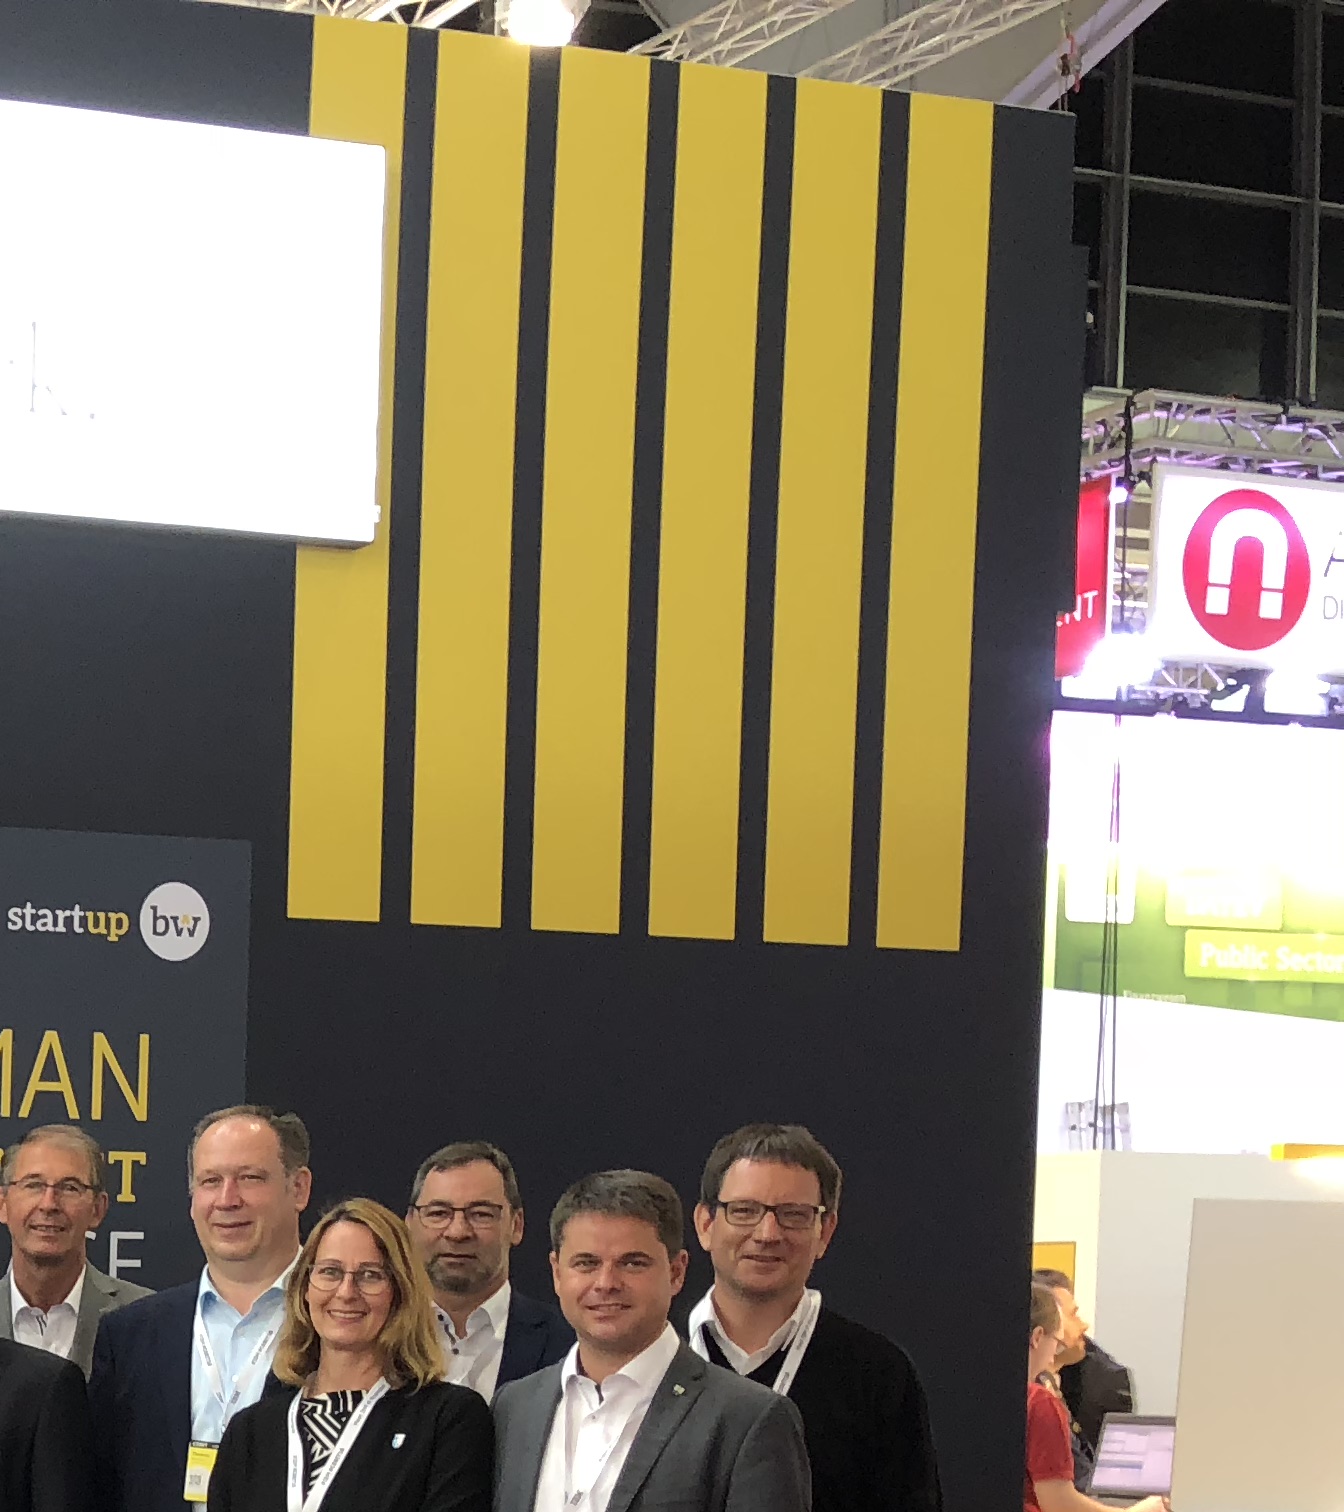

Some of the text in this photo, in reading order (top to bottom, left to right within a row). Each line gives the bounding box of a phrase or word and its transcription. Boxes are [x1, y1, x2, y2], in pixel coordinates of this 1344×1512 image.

[6, 901, 202, 942] startup bw
[1199, 941, 1271, 971] Public
